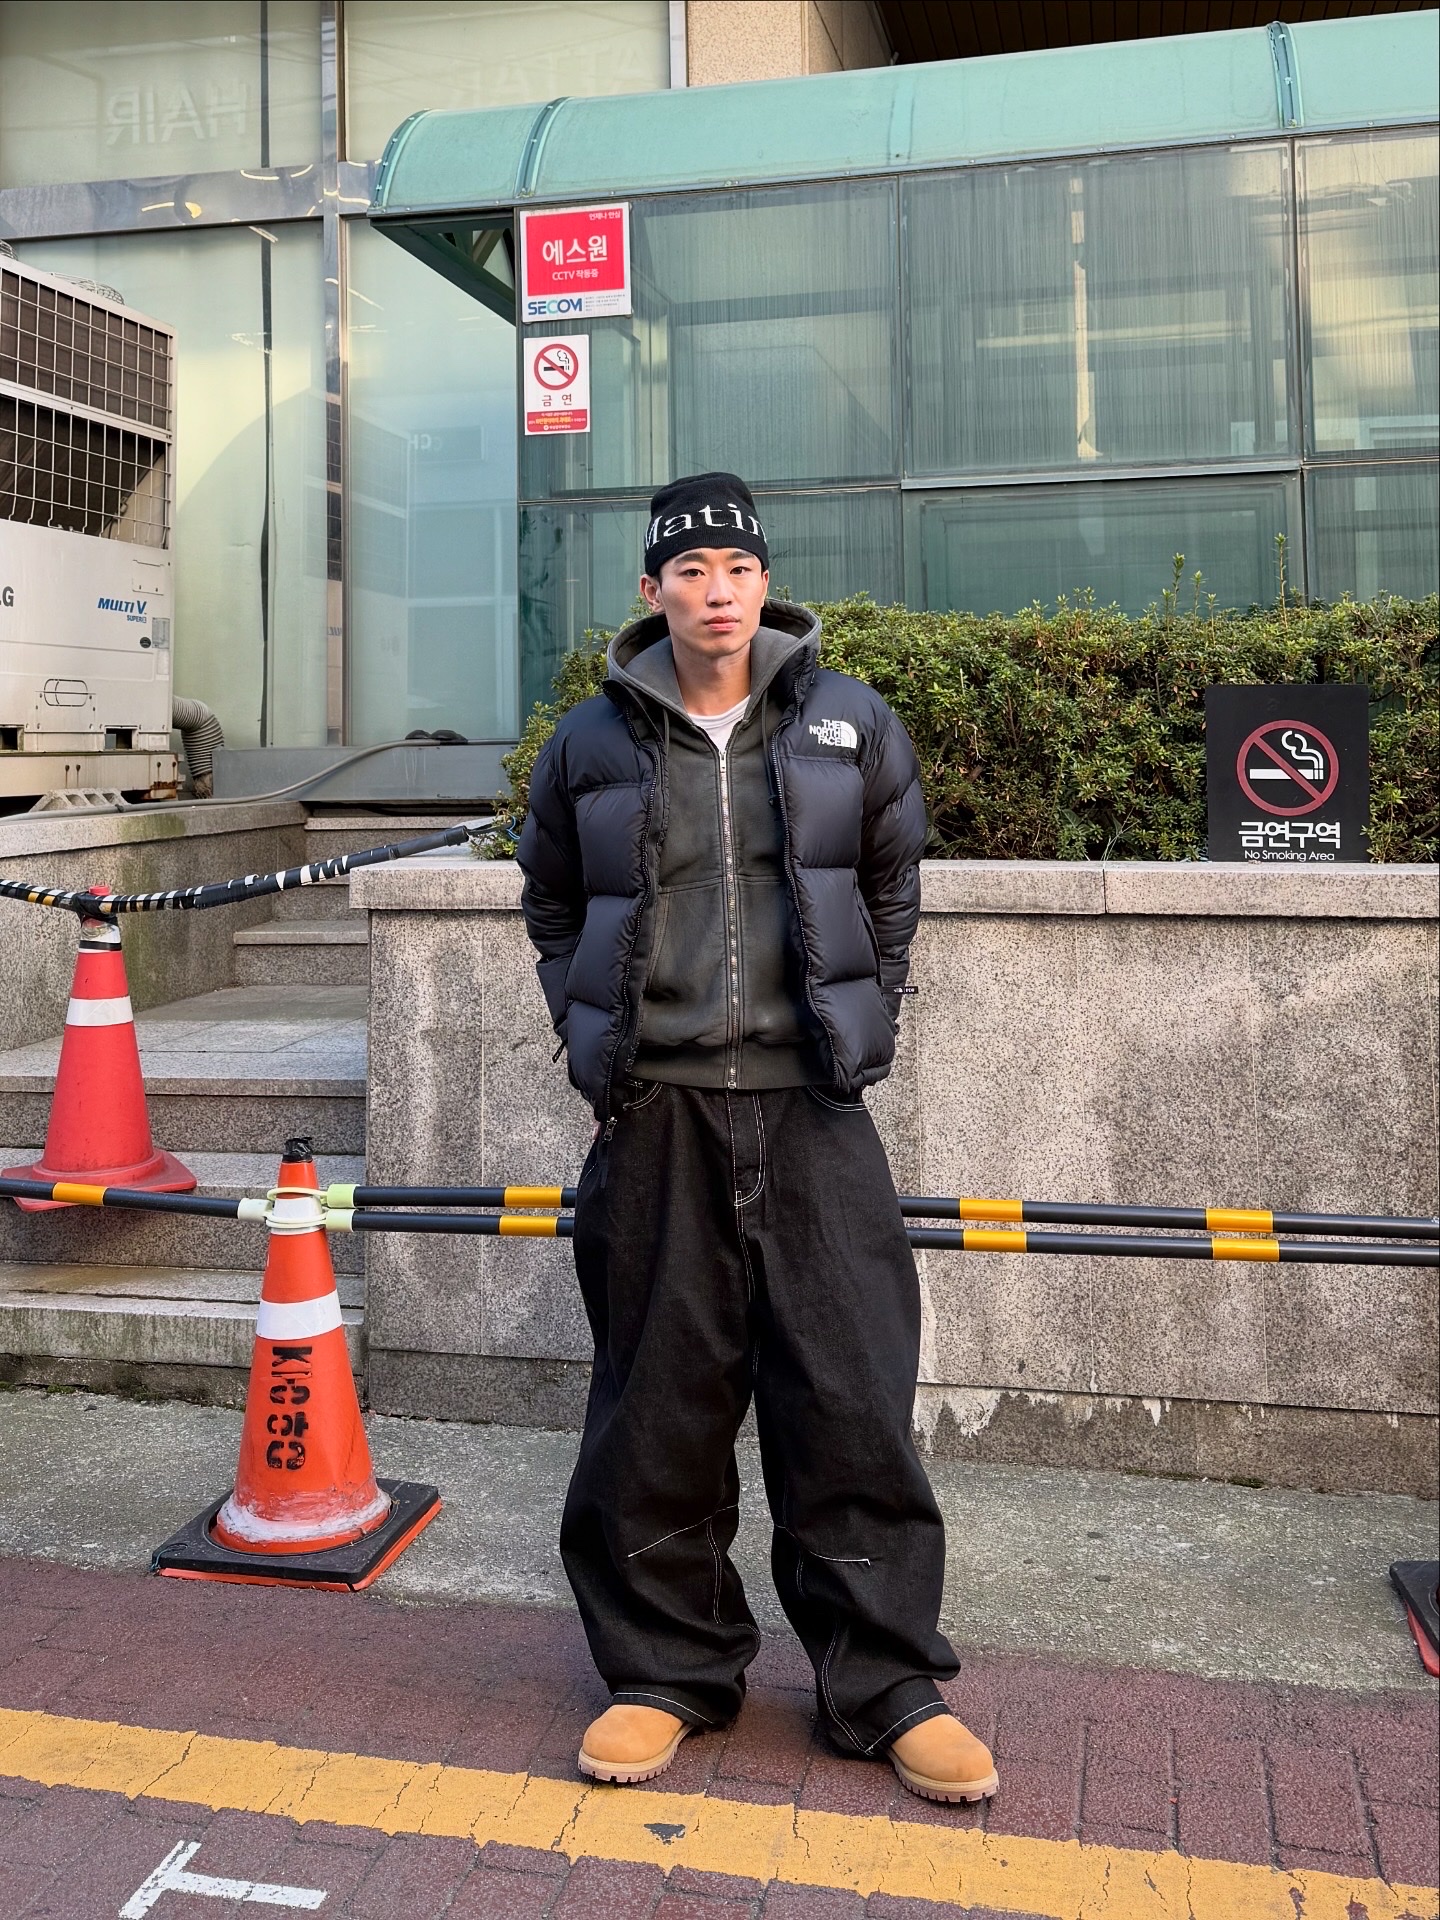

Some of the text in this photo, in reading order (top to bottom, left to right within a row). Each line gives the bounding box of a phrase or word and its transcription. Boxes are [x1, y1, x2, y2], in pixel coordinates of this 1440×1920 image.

[542, 235, 608, 266] 에스원
[552, 268, 599, 281] CCTV 작동중
[527, 297, 583, 316] SECOM
[0, 585, 15, 608] G
[97, 597, 135, 613] MULTI
[821, 718, 842, 729] THE
[808, 724, 842, 739] NORTH
[817, 735, 842, 747] FACE
[1238, 821, 1341, 849] 금연구역
[1244, 850, 1335, 862] No Smoking Area
